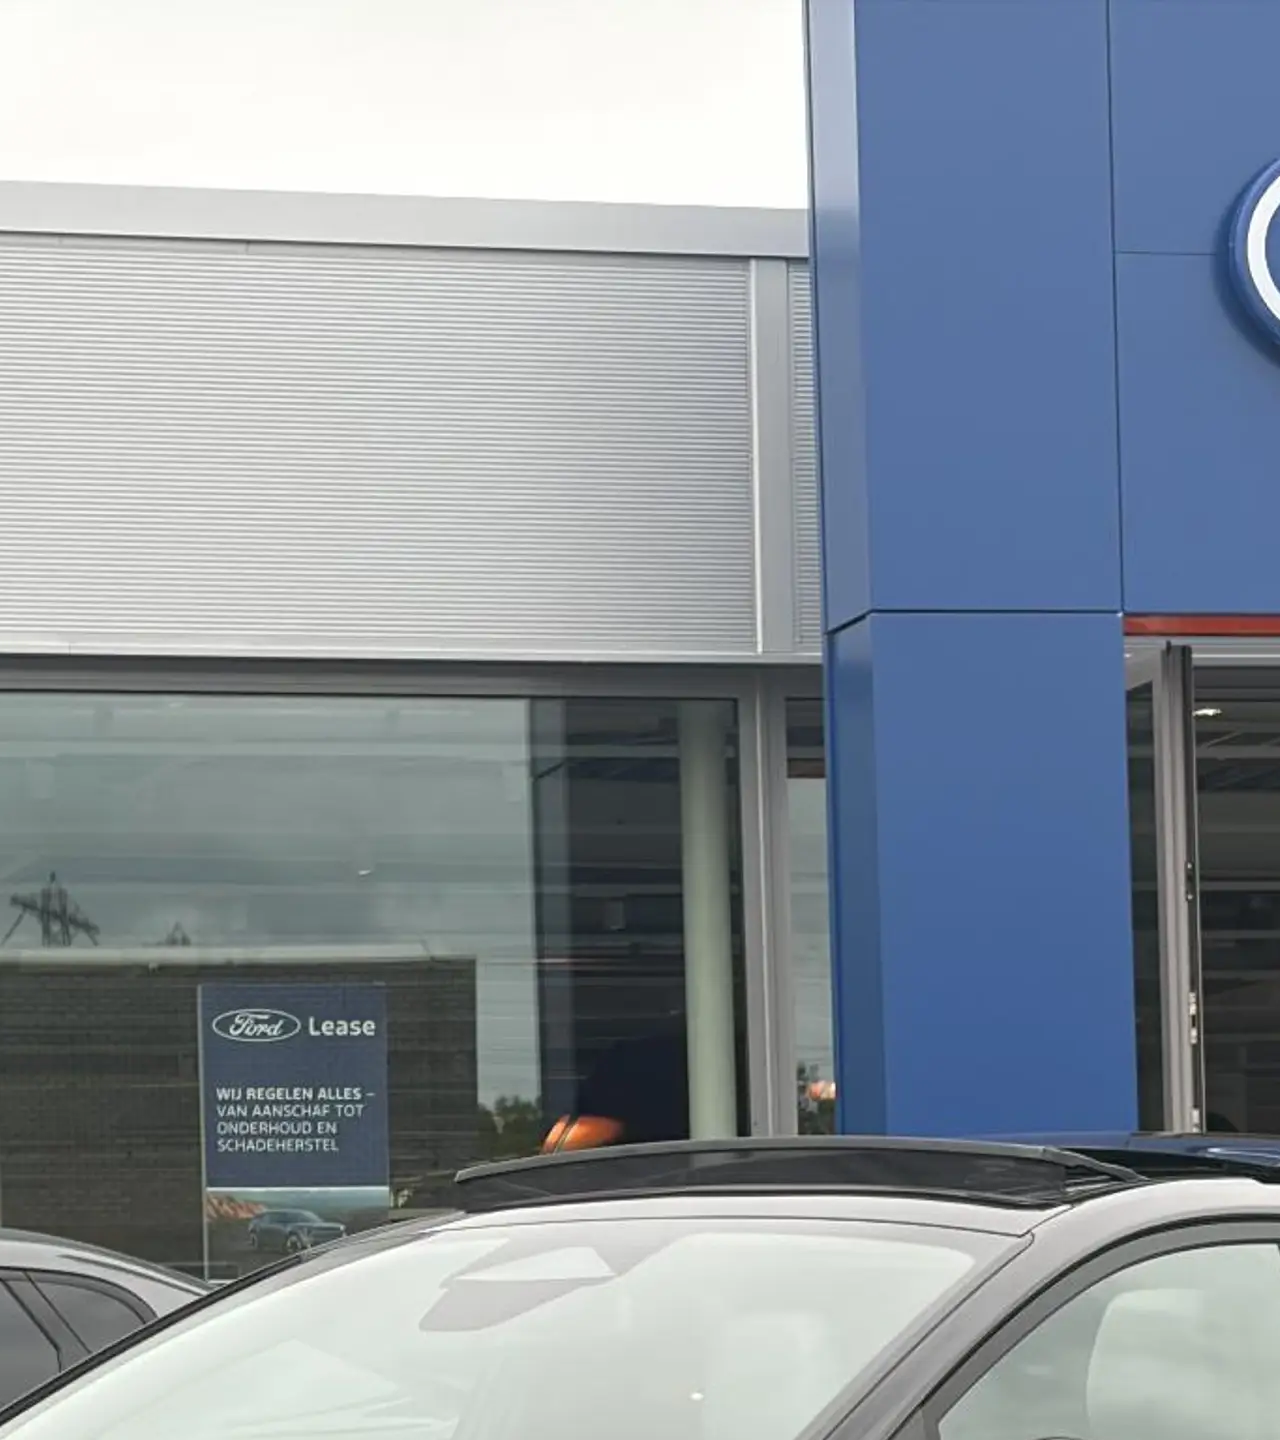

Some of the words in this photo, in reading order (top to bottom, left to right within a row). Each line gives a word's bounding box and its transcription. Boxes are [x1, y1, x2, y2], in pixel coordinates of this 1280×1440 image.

[229, 1011, 284, 1037] Ford
[308, 1016, 376, 1036] Lease
[216, 1087, 241, 1101] WIJ
[246, 1087, 313, 1101] REGELEN
[317, 1087, 362, 1101] ALLES
[216, 1104, 247, 1117] VAN
[252, 1104, 330, 1117] AANSCHAF
[336, 1104, 364, 1117] TOT
[217, 1121, 312, 1135] ONDERHOUD
[317, 1121, 337, 1135] EN
[217, 1138, 339, 1153] SCHADEHERSTEL
